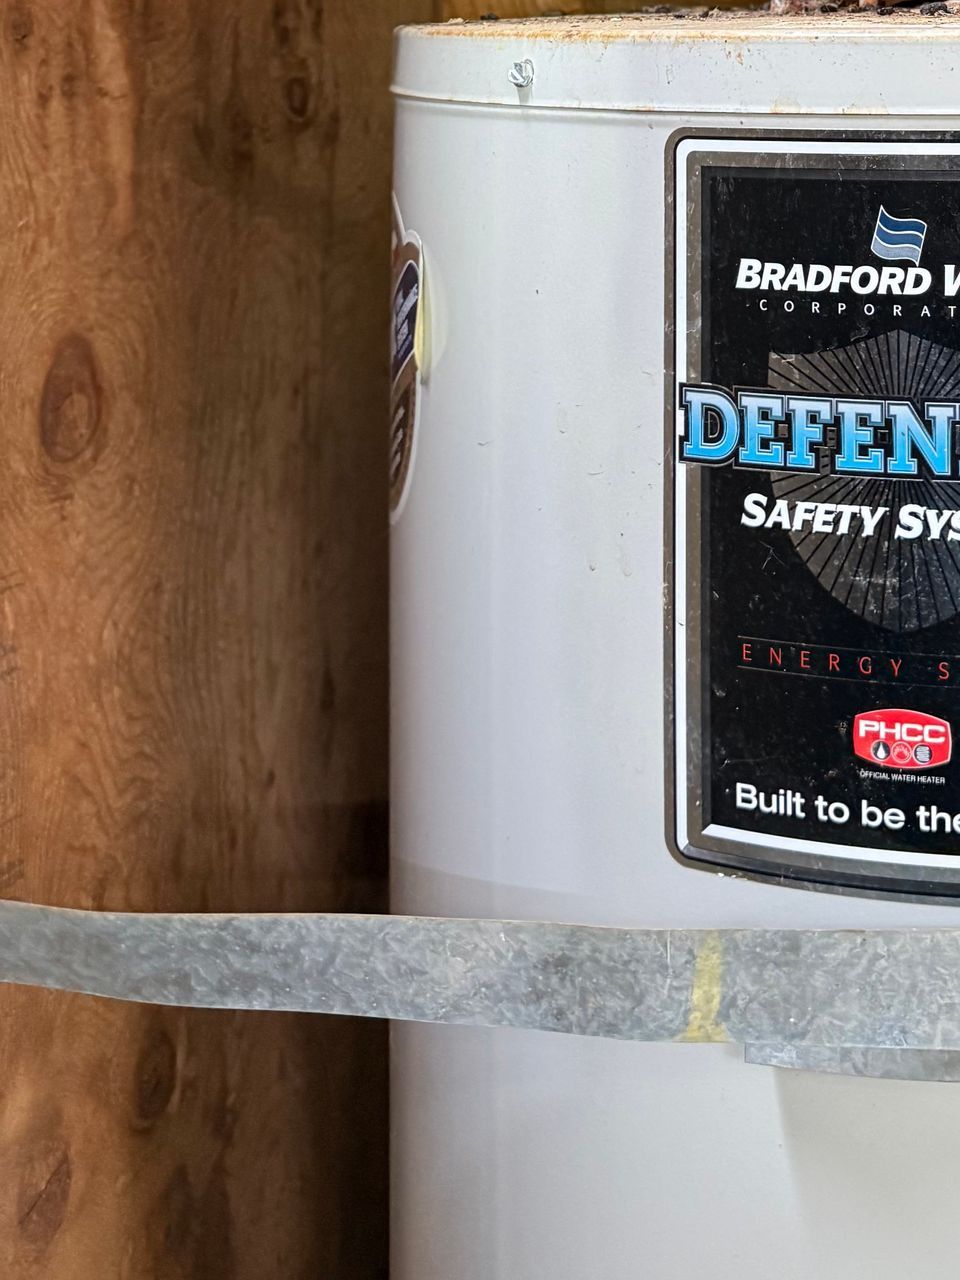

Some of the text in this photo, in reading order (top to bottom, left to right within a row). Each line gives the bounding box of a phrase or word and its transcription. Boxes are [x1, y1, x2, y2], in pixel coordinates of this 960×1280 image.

[735, 258, 932, 296] BRADFORD
[741, 493, 889, 537] SAFETY
[742, 643, 903, 676] ENERGY
[859, 719, 946, 744] PHCC
[859, 769, 946, 784] OFFICIAL WATER HEATER
[735, 782, 806, 818] Built
[814, 794, 850, 824] to
[861, 799, 906, 829] be
